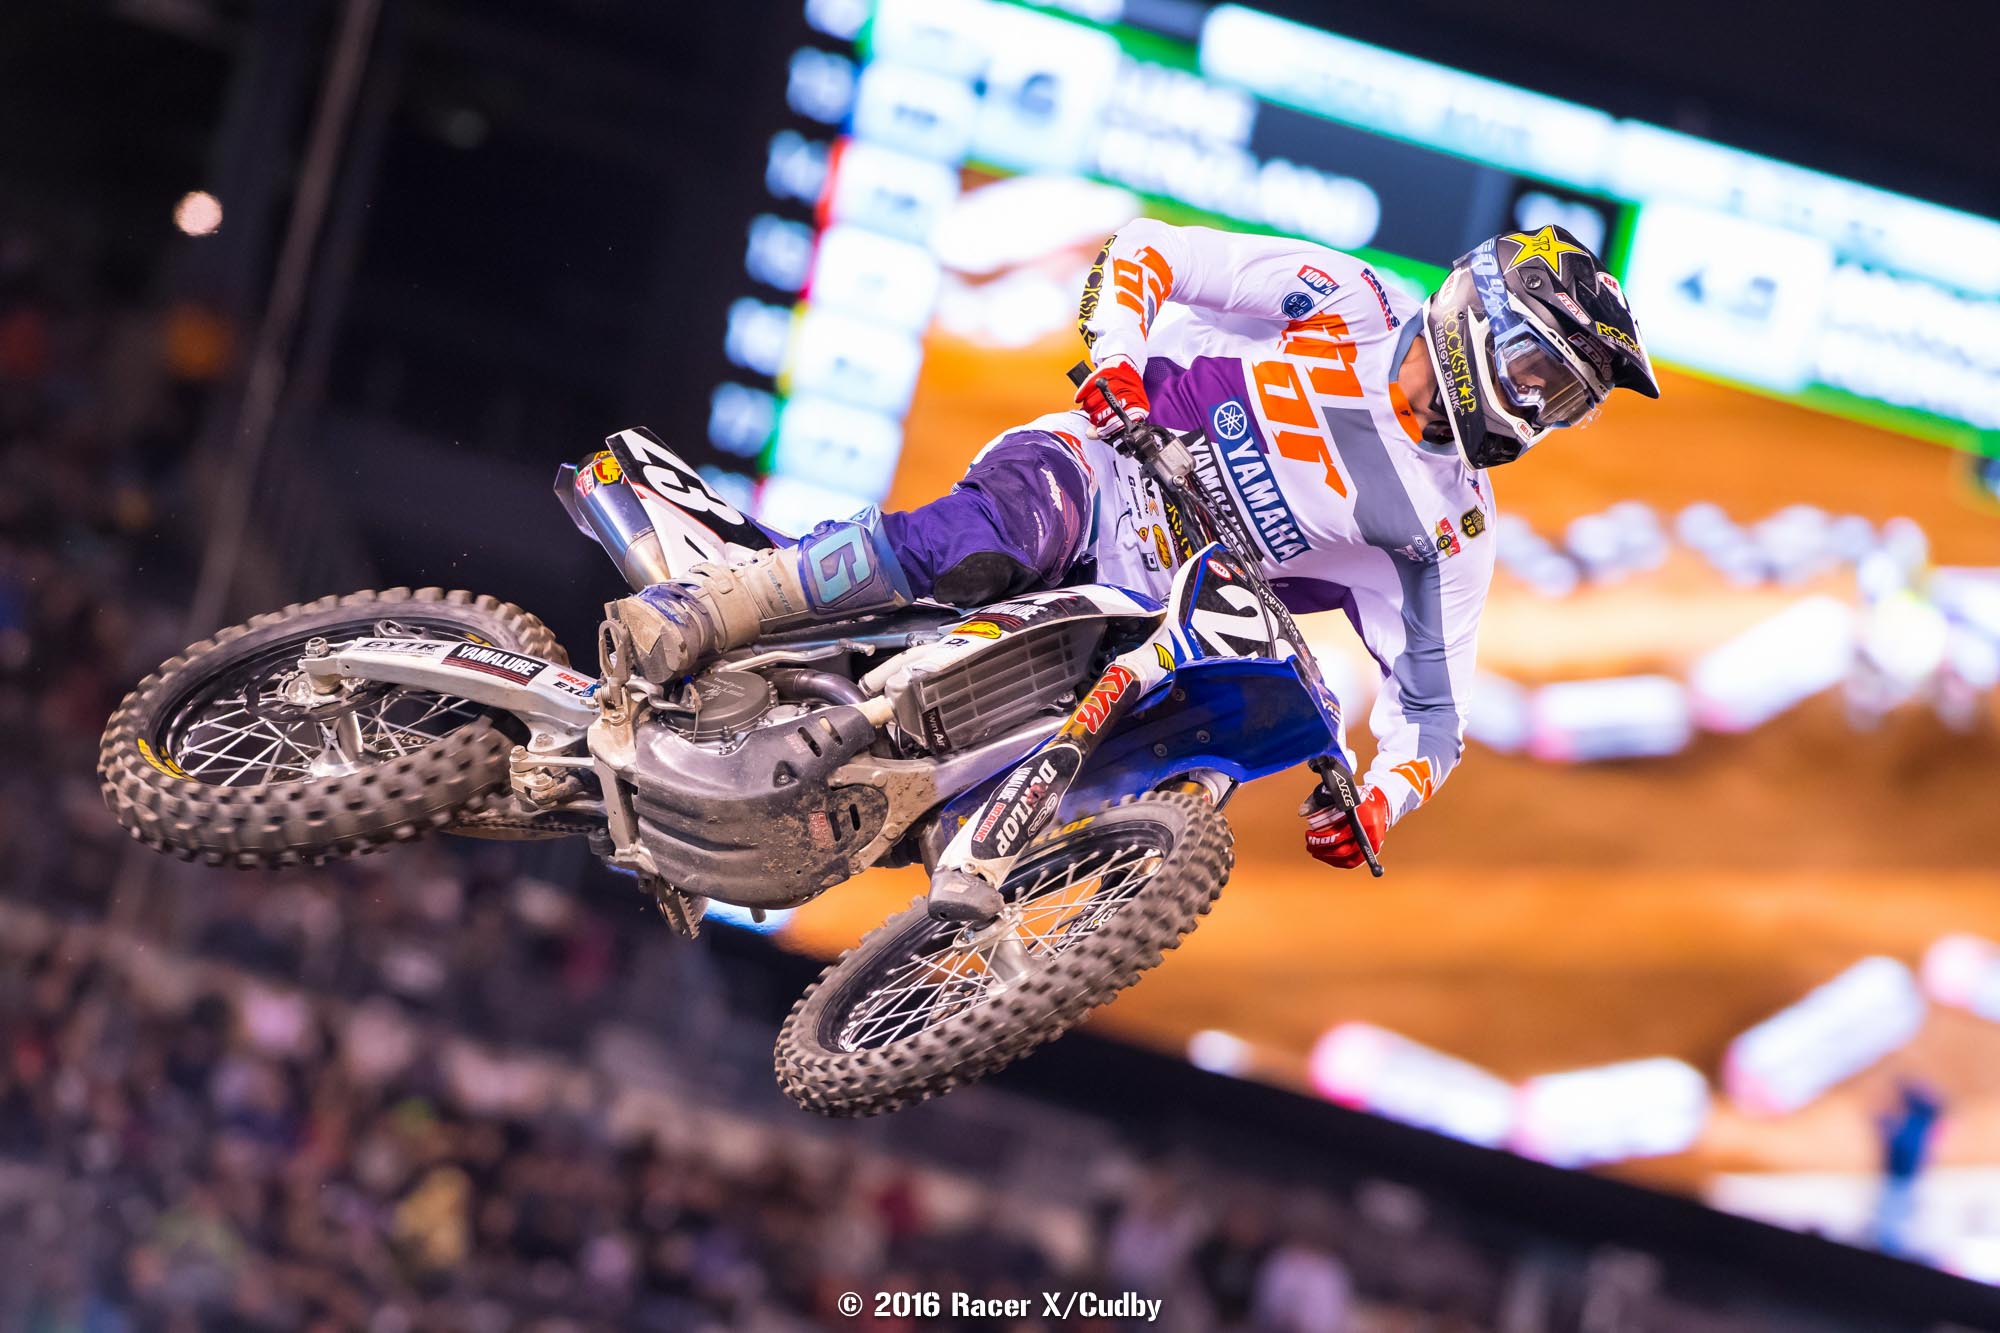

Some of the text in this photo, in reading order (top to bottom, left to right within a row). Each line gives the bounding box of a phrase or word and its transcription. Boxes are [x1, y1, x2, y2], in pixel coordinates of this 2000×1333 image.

[1299, 267, 1336, 295] 100%
[1434, 322, 1450, 371] ENERGY
[1226, 436, 1306, 562] YAMAHA
[456, 644, 541, 678] YAMALUBE
[1331, 769, 1355, 807] ARC
[973, 801, 1007, 843] BRAKING
[1308, 832, 1341, 846] thor
